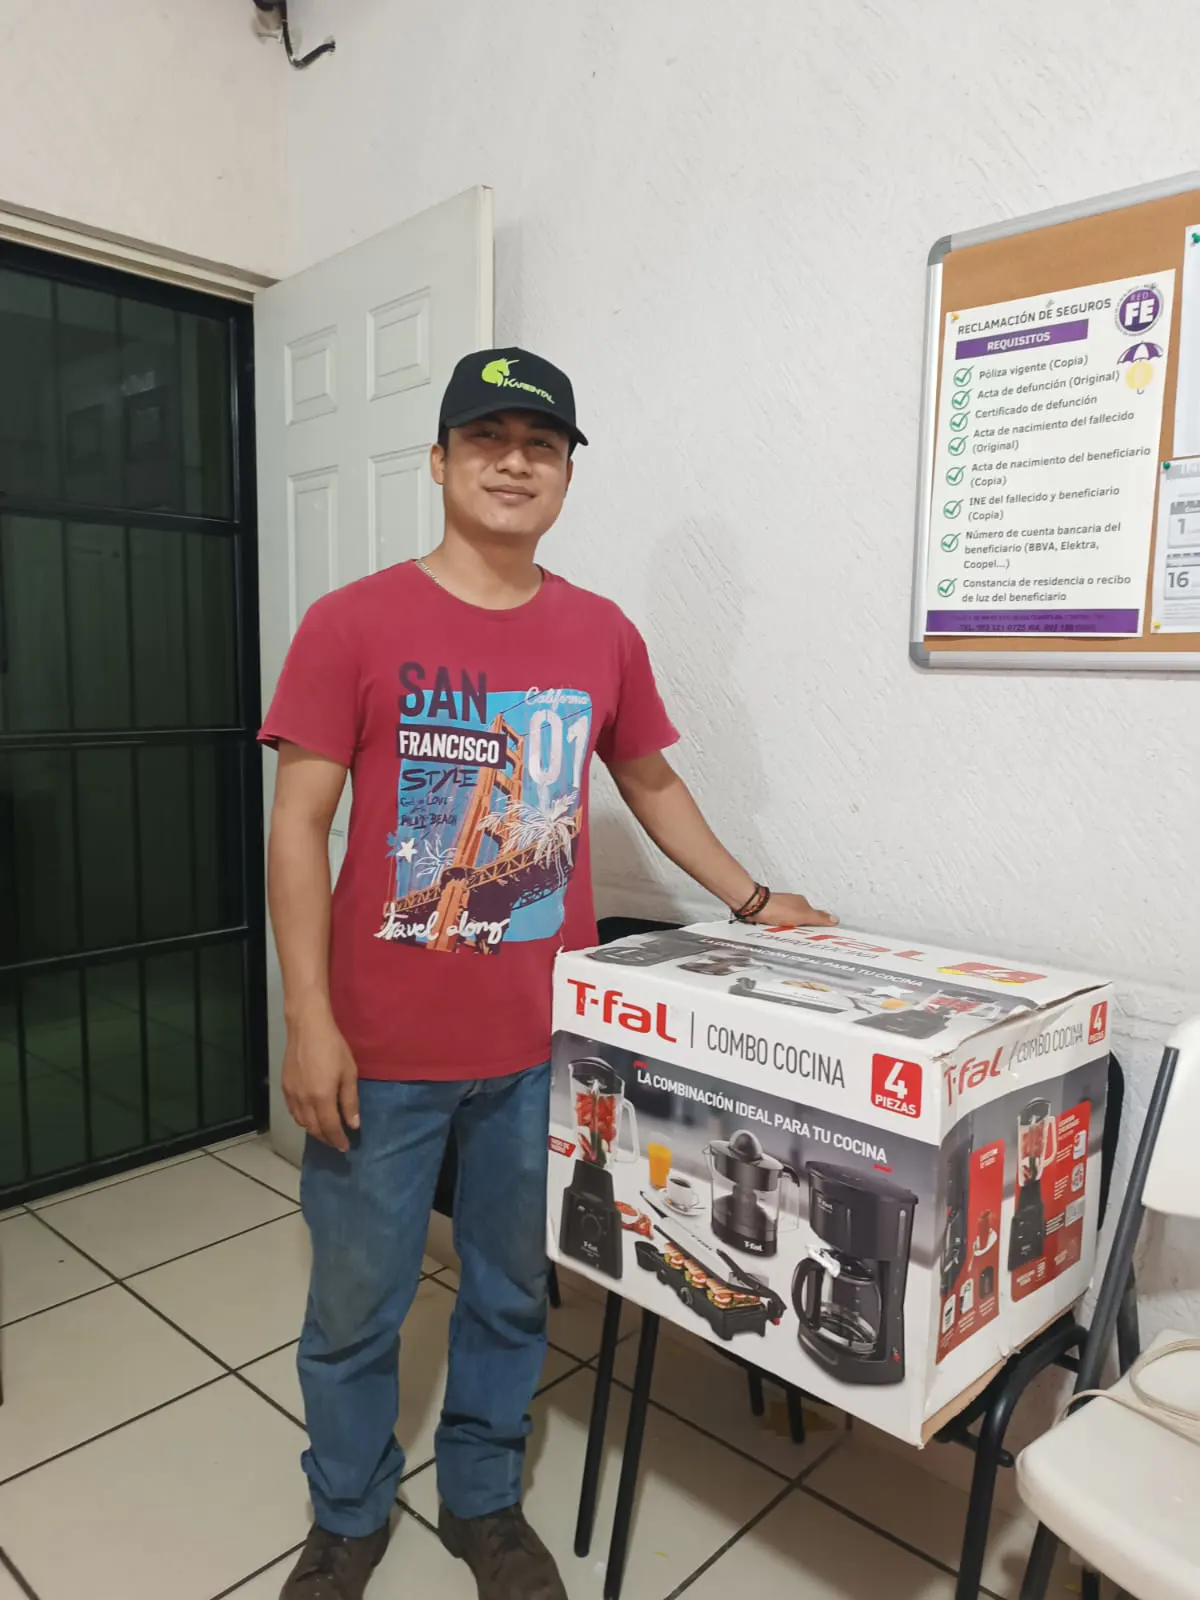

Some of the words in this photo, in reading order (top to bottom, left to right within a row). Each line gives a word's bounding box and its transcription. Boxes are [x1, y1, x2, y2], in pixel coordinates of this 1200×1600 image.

[958, 311, 1036, 335] RECLAMACIÓN
[1038, 309, 1053, 321] DE
[1056, 298, 1112, 318] SEGUROS
[1125, 298, 1155, 326] FE
[987, 332, 1051, 351] REQUISITOS
[979, 367, 1007, 380] Póliza
[1010, 362, 1047, 376] vigente
[1049, 354, 1088, 371] (Copia)
[977, 389, 999, 399] Acta
[1001, 387, 1014, 397] de
[1016, 379, 1066, 394] defunción
[1069, 370, 1120, 388] (Original)
[975, 404, 1029, 419] Certificado
[1031, 402, 1043, 412] de
[1046, 395, 1098, 410] defunción
[973, 428, 995, 438] Acta
[997, 426, 1010, 436] de
[1012, 420, 1068, 434] nacimiento
[1071, 416, 1087, 428] del
[1089, 411, 1135, 425] fallecido
[972, 440, 1019, 454] (Original)
[972, 462, 993, 472] Acta
[995, 460, 1008, 470] de
[1010, 455, 1066, 468] nacimiento
[1068, 452, 1085, 463] del
[1087, 446, 1151, 461] beneficiario
[970, 475, 1007, 488] (Copia)
[969, 496, 986, 506] INE
[988, 495, 1003, 505] del
[1005, 491, 1048, 504] fallecido
[1050, 493, 1056, 502] y
[1059, 486, 1120, 500] beneficiario
[967, 510, 1004, 522] (Copia)
[966, 528, 1004, 539] Número
[1006, 528, 1019, 538] de
[1021, 527, 1054, 537] cuenta
[1057, 522, 1102, 535] bancaria
[1104, 521, 1121, 532] del
[964, 543, 1022, 555] beneficiario
[1024, 541, 1058, 554] (BBVA,
[1060, 540, 1100, 551] Elektra,
[962, 578, 1016, 588] Constancia
[1018, 577, 1031, 587] de
[1033, 575, 1085, 587] residencia
[1087, 577, 1094, 585] o
[1096, 574, 1132, 585] recibo
[1168, 571, 1190, 588] 16
[962, 593, 974, 602] de
[975, 593, 989, 602] luz
[991, 592, 1007, 602] del
[1009, 591, 1067, 602] beneficiario
[398, 661, 487, 724] SAN
[399, 730, 500, 764] FRANCISCO
[528, 709, 589, 788] 01
[400, 767, 479, 793] STYLE
[567, 978, 677, 1043] T-fal
[707, 1024, 768, 1065] COMBO
[773, 1042, 845, 1088] COCINA
[1016, 1032, 1050, 1063] COMBO
[1052, 1023, 1084, 1051] COCINA
[884, 1062, 908, 1099] 4
[637, 1069, 652, 1086] LA
[652, 1075, 734, 1113] COMBINACIÓN
[735, 1101, 772, 1126] IDEAL
[774, 1114, 811, 1138] PARA
[812, 1125, 831, 1144] TU
[833, 1133, 888, 1164] COCINA
[875, 1093, 917, 1115] PIEZAS
